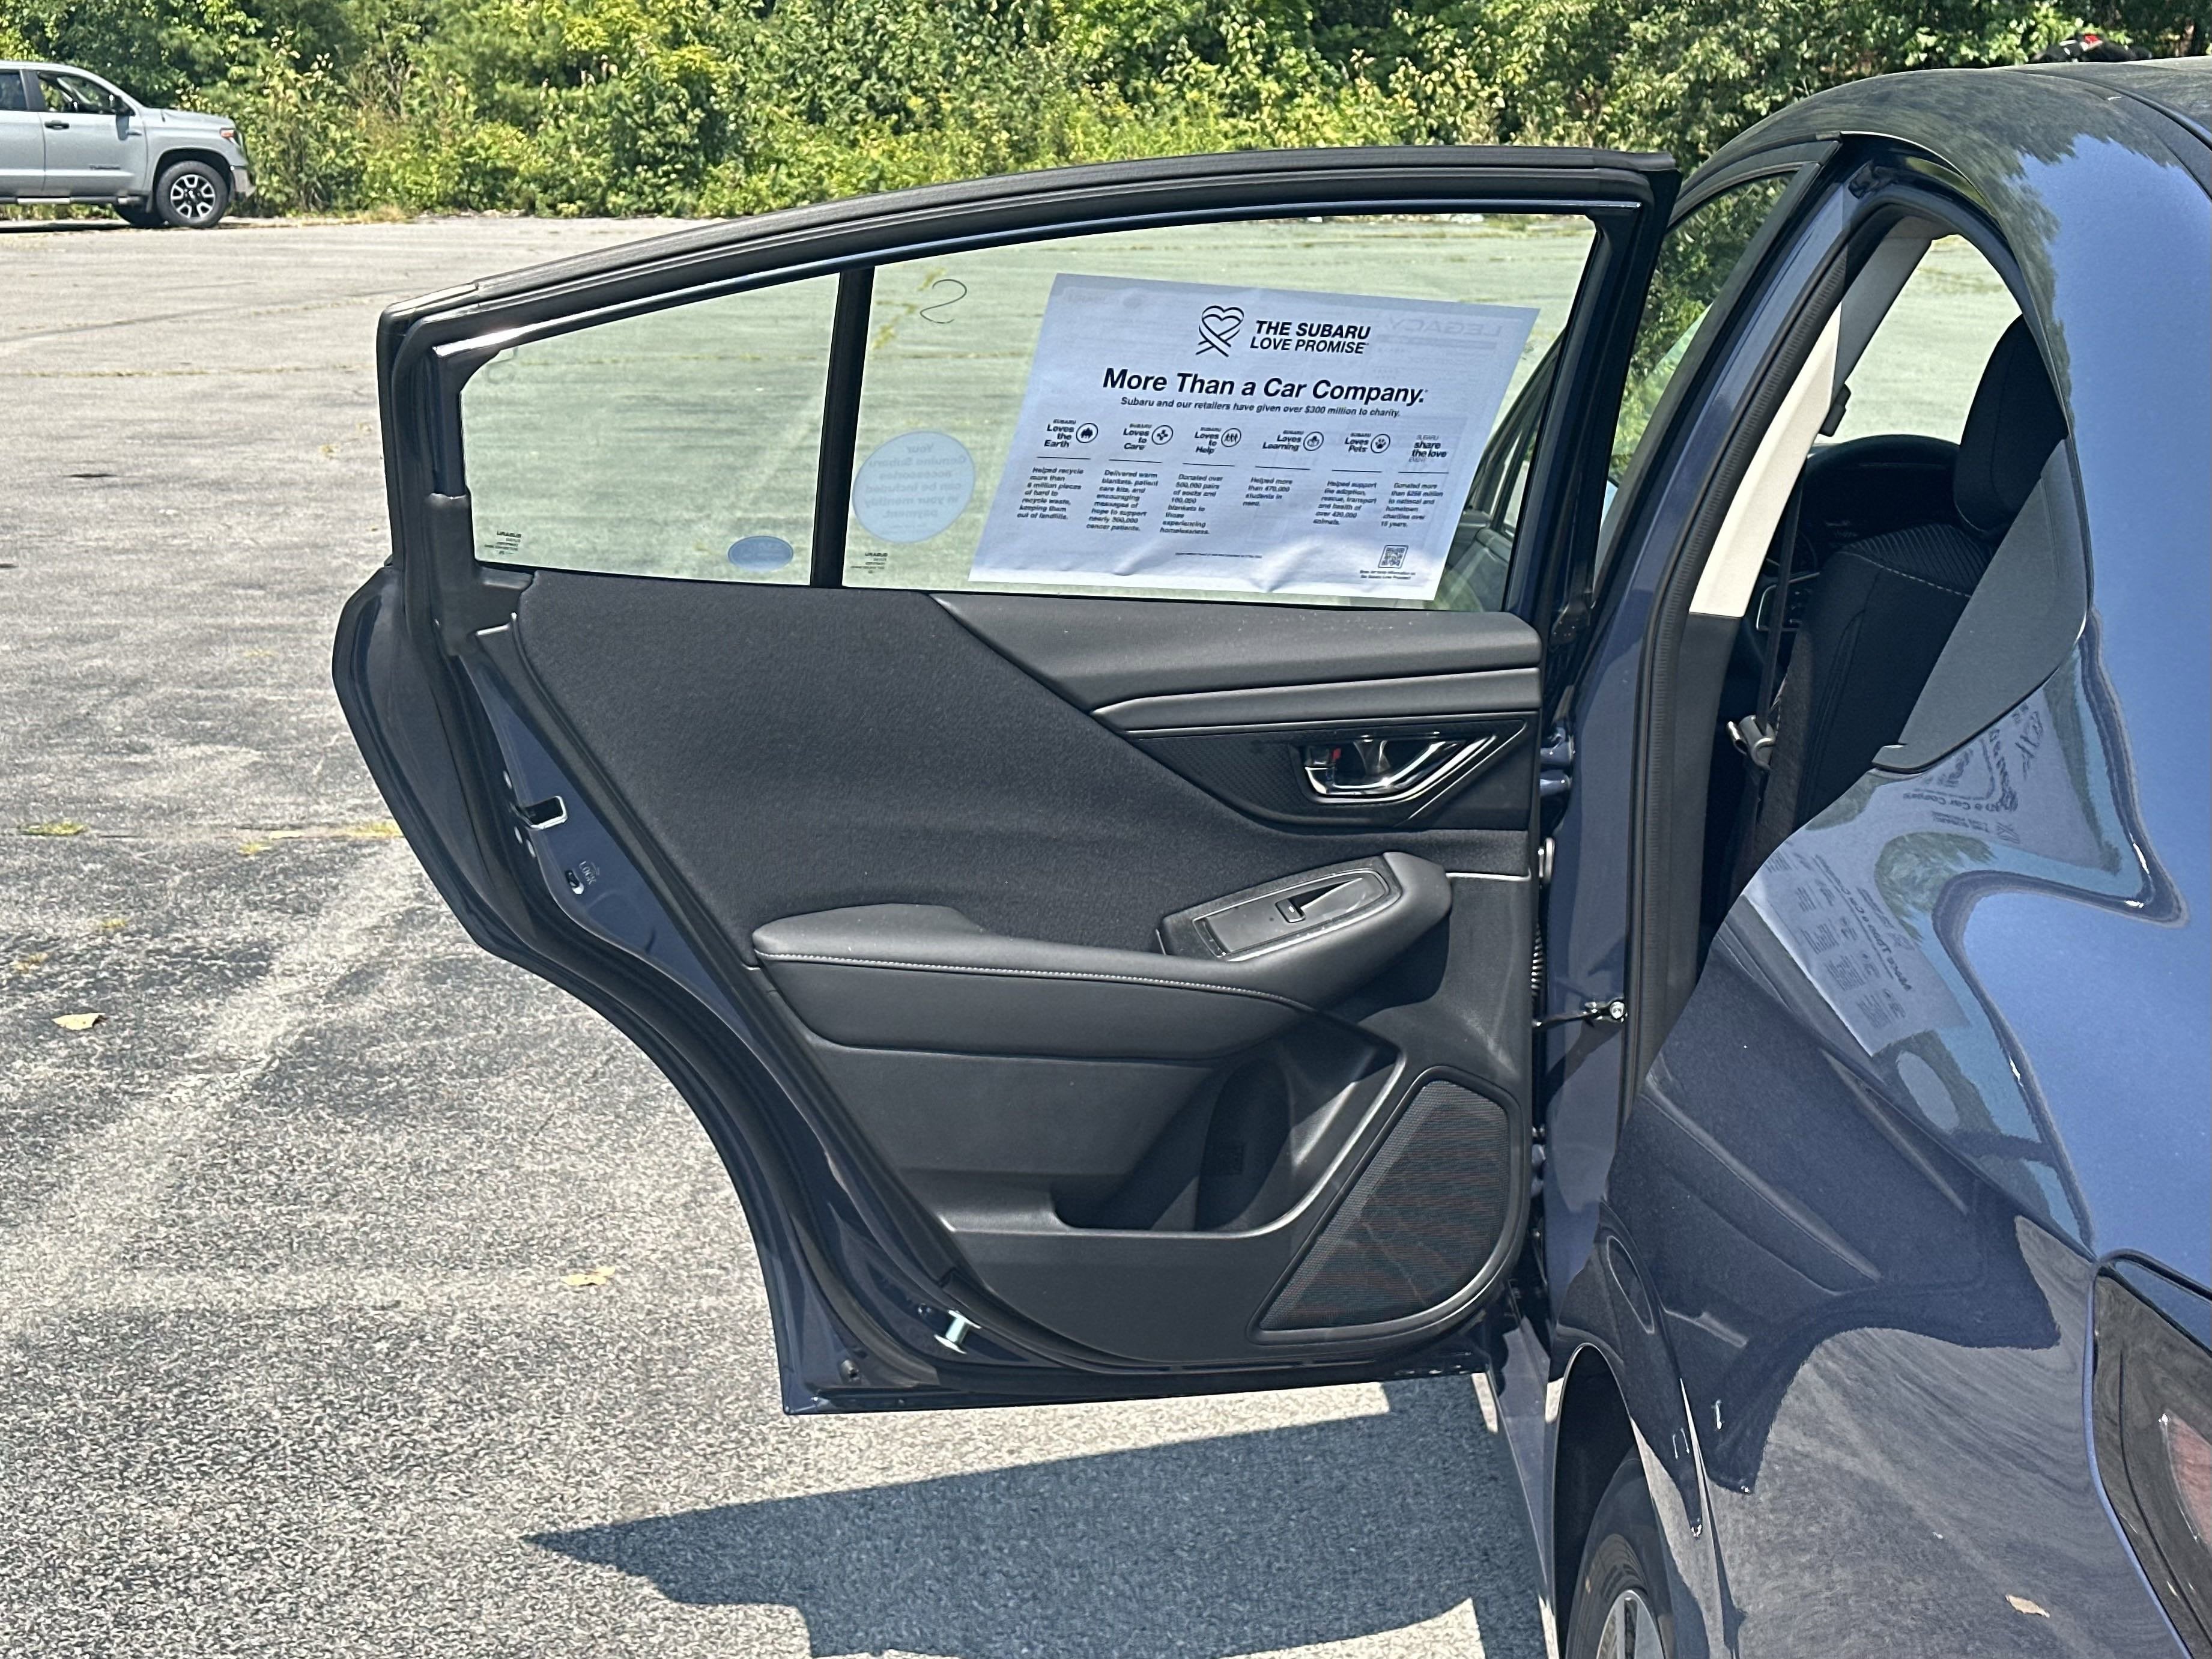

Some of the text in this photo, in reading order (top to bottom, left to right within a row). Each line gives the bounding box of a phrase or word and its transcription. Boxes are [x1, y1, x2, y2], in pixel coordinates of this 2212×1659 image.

[1255, 320, 1371, 340] THE SUBARU
[1250, 336, 1291, 351] LOVE
[1295, 339, 1366, 354] PROMISE
[1103, 368, 1425, 406] More Than a Car Company.
[1120, 396, 1154, 406] Subaru
[1194, 401, 1231, 410] retailers
[1233, 402, 1255, 411] have
[1256, 404, 1280, 413] given
[1304, 405, 1326, 414] $300
[1327, 407, 1357, 415] million
[1370, 408, 1400, 418] charity.
[1047, 424, 1074, 432] Loves
[1262, 442, 1300, 451] Learning
[1345, 437, 1369, 446] Loves
[1196, 446, 1214, 455] Help
[1412, 449, 1426, 458] the
[579, 861, 596, 885] LOCK
